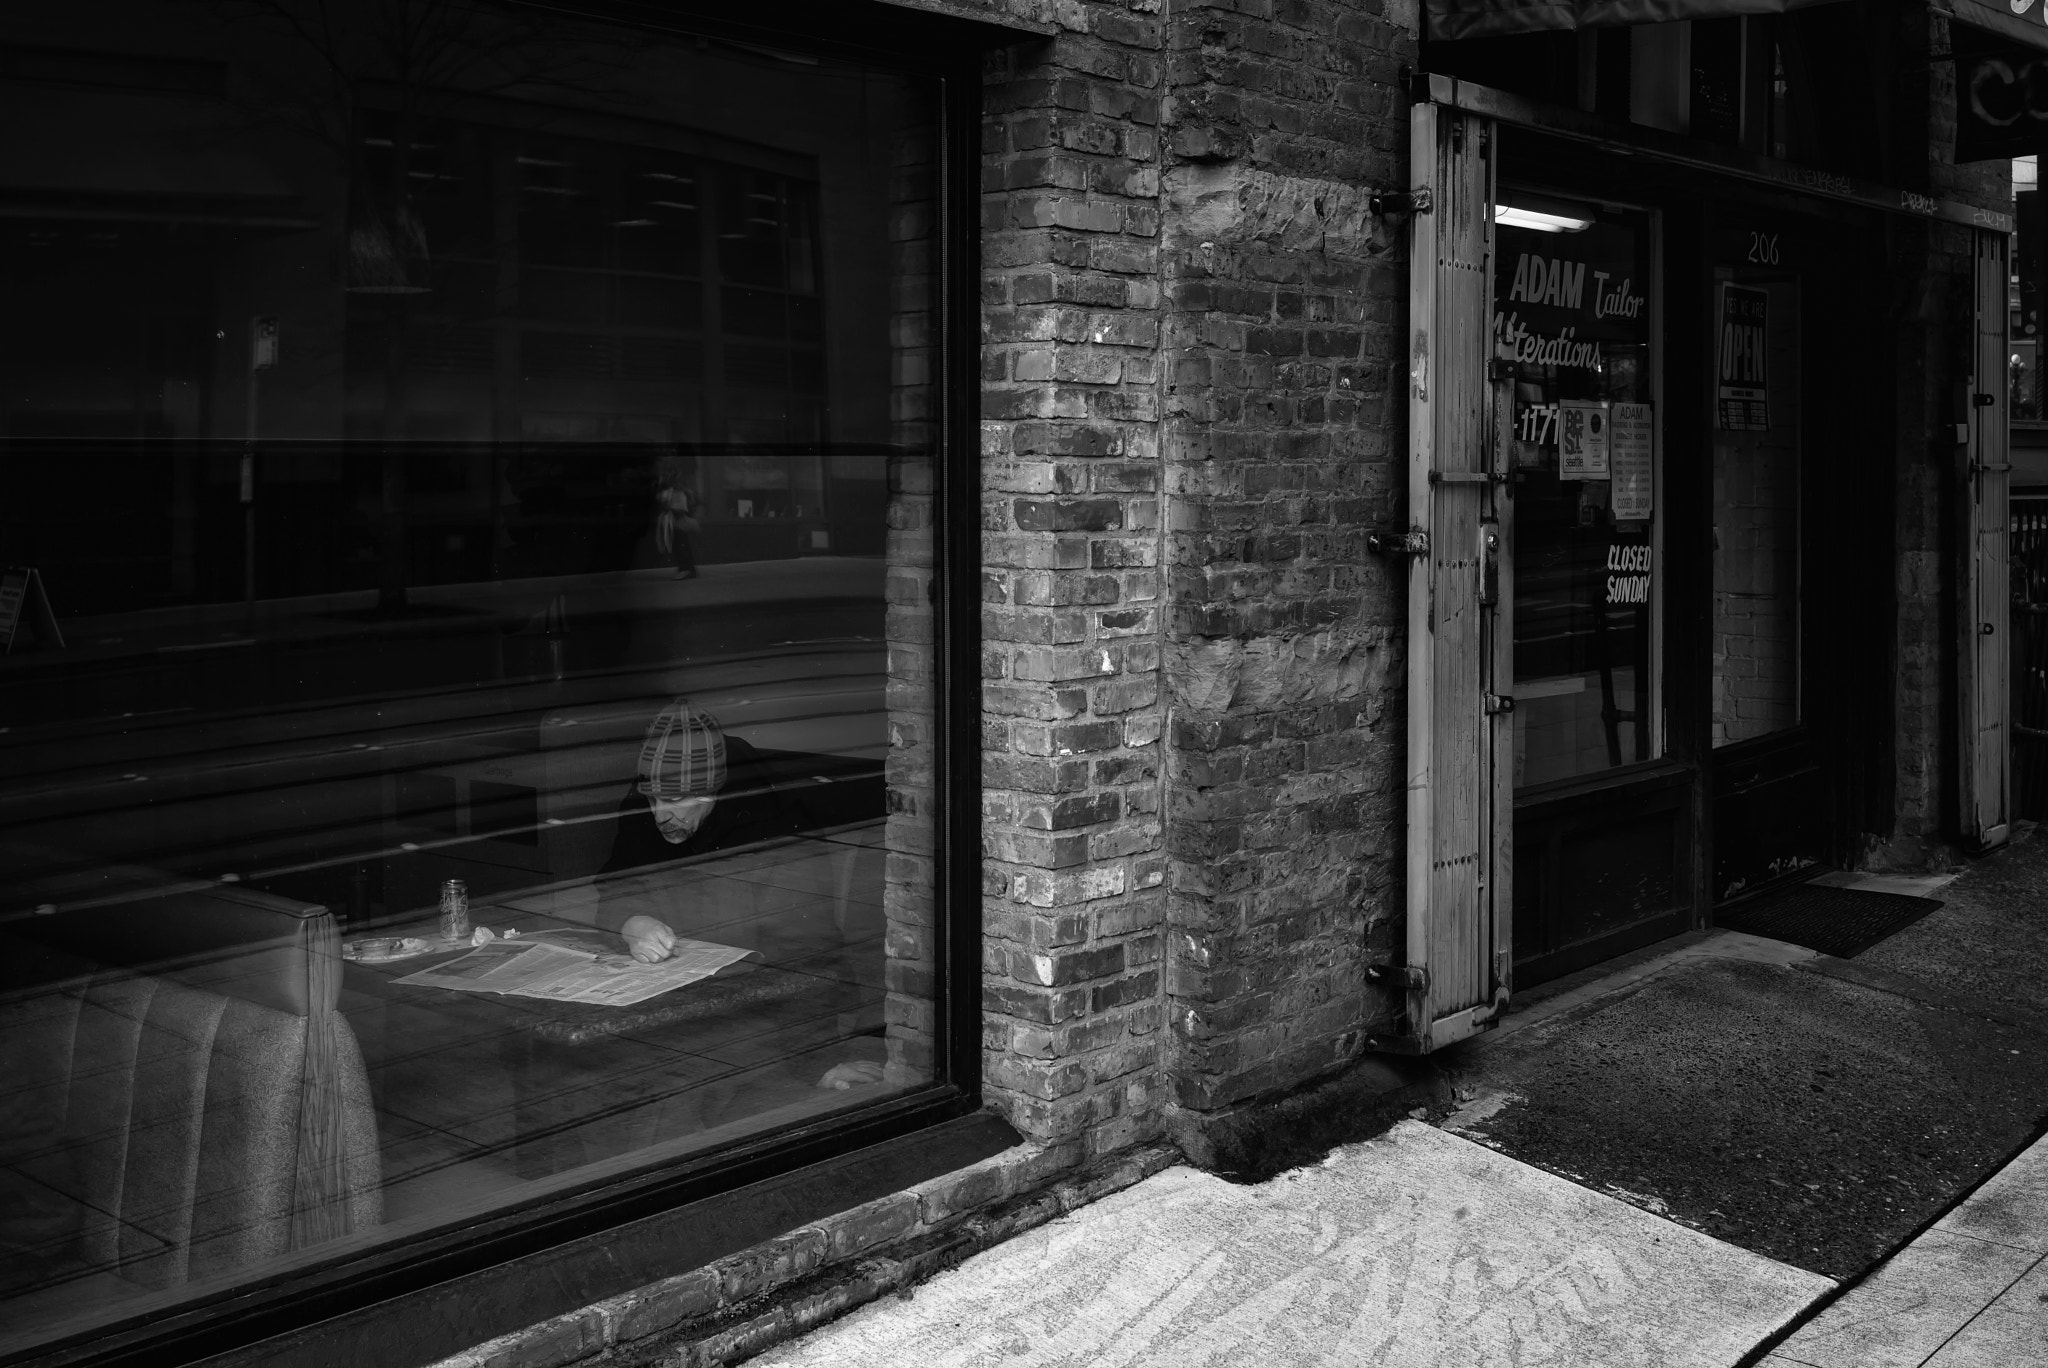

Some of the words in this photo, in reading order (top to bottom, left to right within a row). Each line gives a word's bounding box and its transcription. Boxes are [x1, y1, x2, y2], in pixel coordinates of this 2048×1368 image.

[1748, 231, 1779, 265] 206
[1509, 253, 1585, 309] ADAM
[1593, 270, 1645, 319] Tailor
[1726, 295, 1737, 314] YES
[1752, 301, 1765, 319] ARE
[1722, 321, 1764, 382] OPEN
[1620, 406, 1643, 420] ADAM
[1607, 544, 1652, 572] CLOSED
[1605, 572, 1652, 604] SUNDAY
